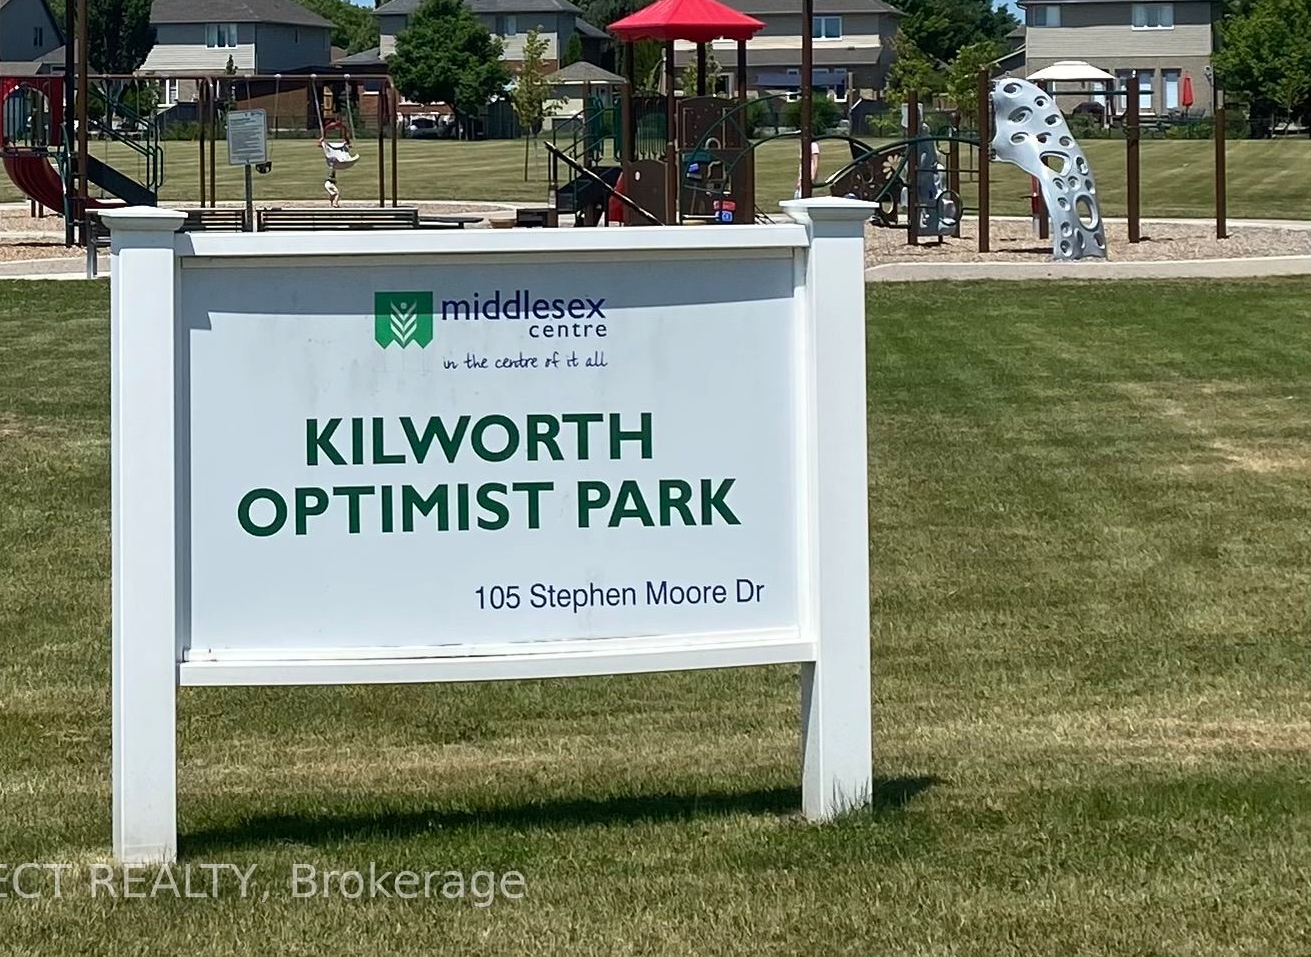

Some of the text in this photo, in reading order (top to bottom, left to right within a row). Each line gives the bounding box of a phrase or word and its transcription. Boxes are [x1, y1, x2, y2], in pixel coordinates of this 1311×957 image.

[441, 289, 606, 321] middlesex
[528, 321, 607, 339] centre
[443, 350, 609, 370] in the centre of it all
[306, 412, 653, 467] KILWORTH
[237, 478, 742, 537] OPTIMIST PARK
[475, 578, 765, 614] 105 Stephen Moore Dr
